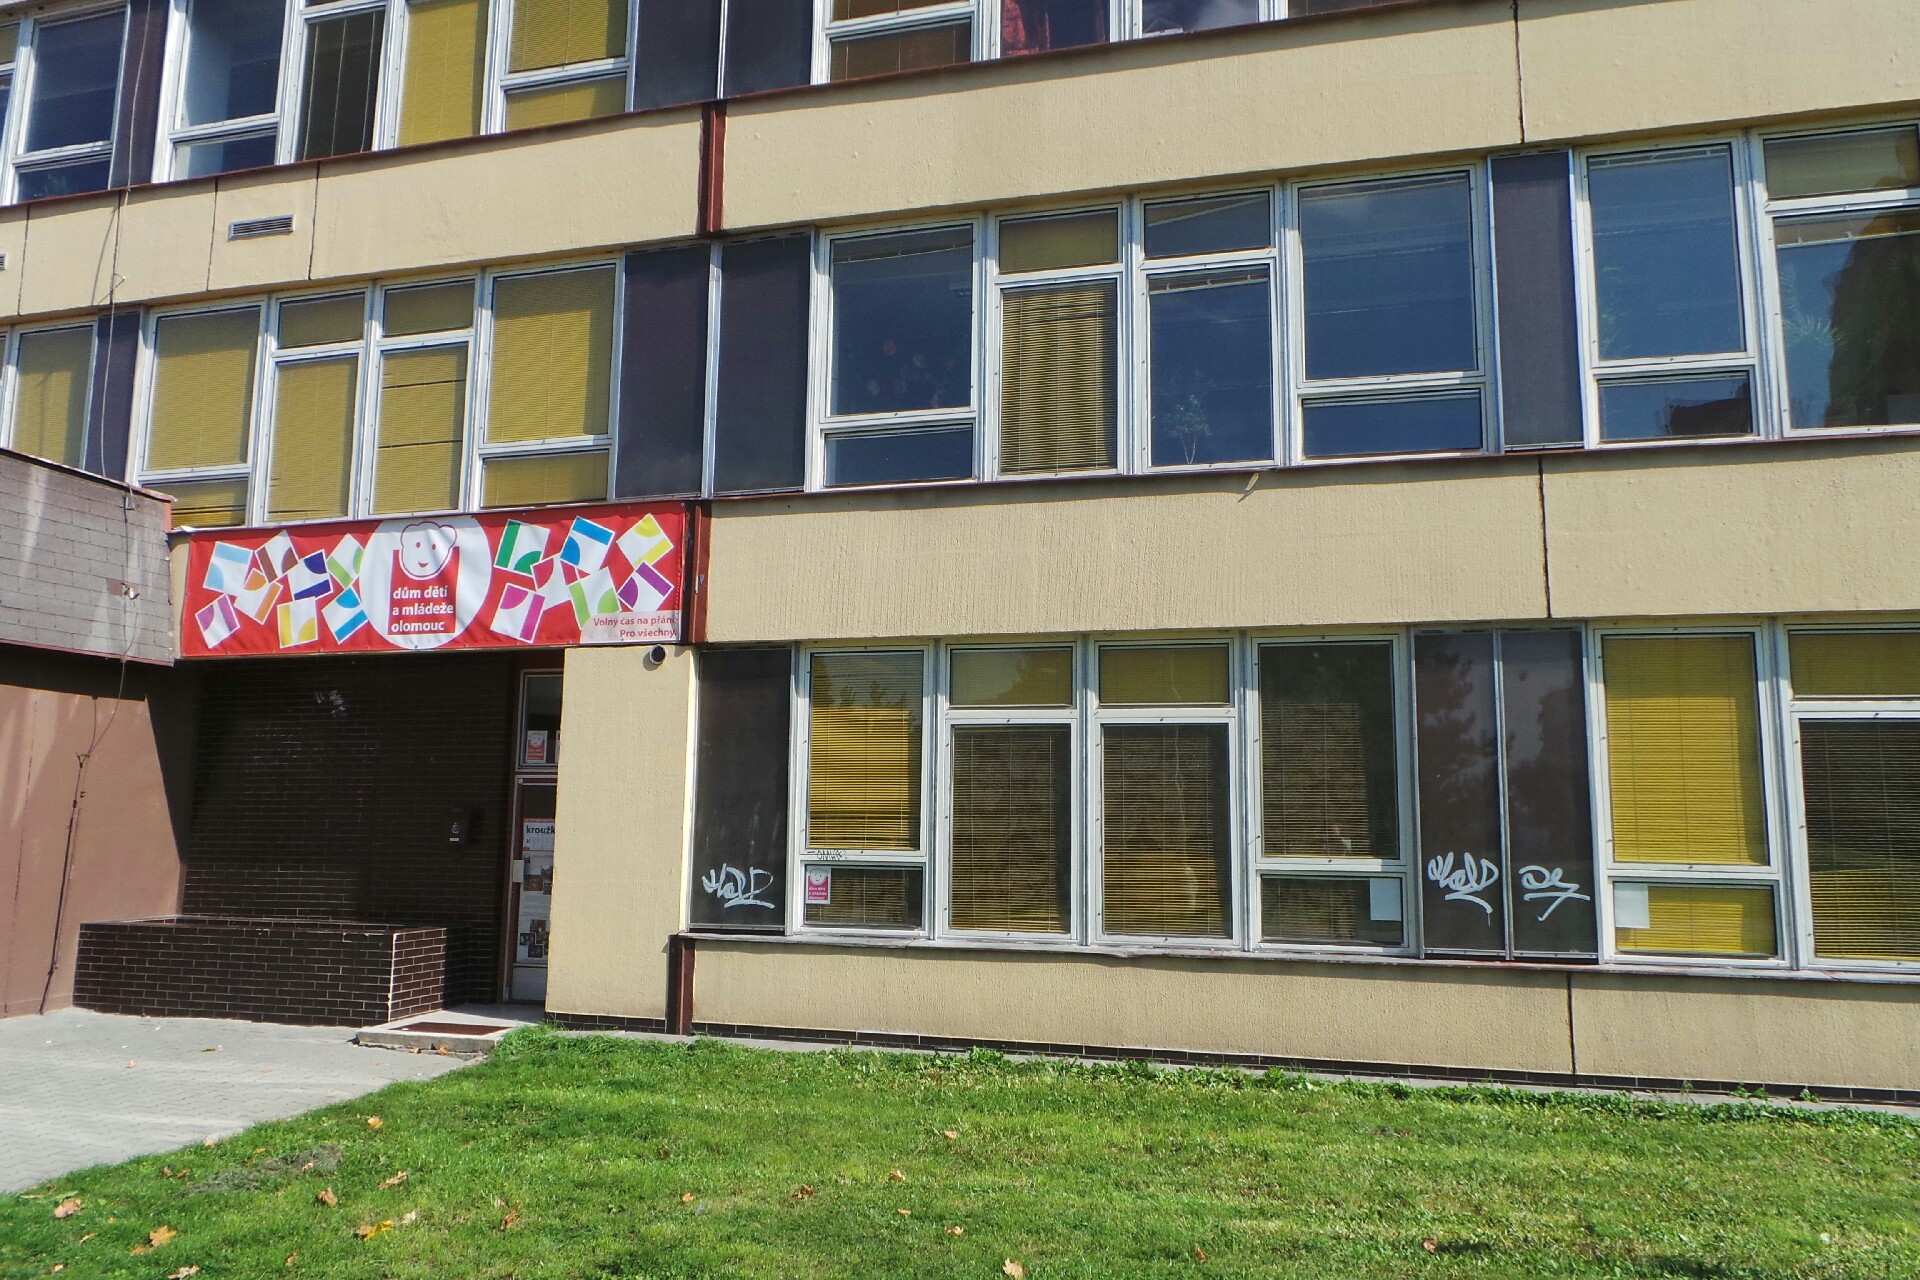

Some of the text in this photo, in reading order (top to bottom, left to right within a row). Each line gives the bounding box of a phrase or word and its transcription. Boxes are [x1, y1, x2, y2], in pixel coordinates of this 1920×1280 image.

[393, 585, 448, 599] dům dětí
[392, 602, 454, 616] a mládeže
[391, 620, 445, 632] olomouc
[593, 617, 619, 627] Volný
[620, 617, 635, 625] čas
[620, 628, 677, 638] Pro všechny.
